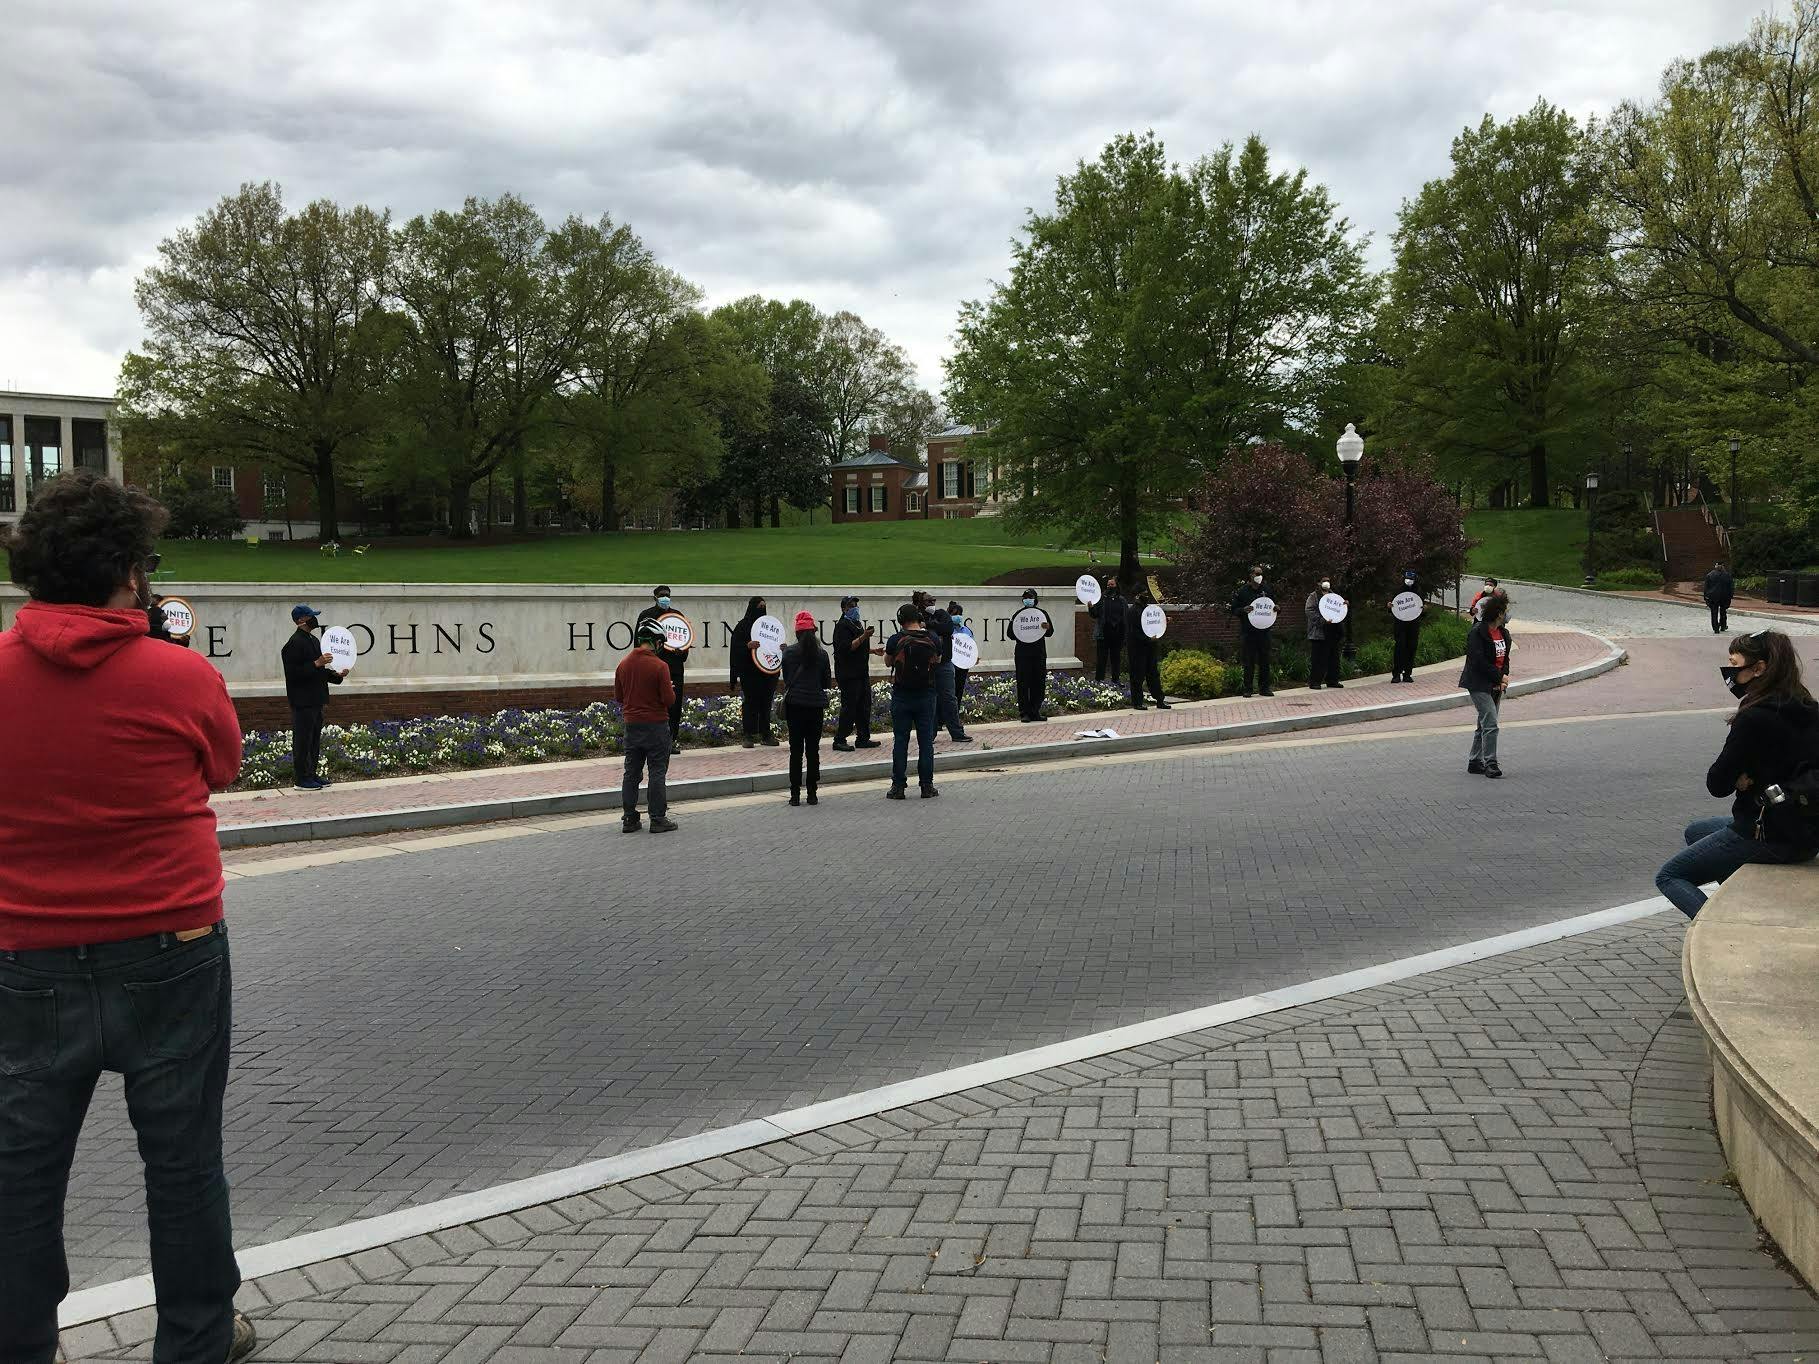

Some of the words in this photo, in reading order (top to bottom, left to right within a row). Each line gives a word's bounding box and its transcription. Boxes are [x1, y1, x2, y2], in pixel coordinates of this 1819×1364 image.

[169, 618, 189, 627] ERE!
[761, 621, 769, 629] We
[770, 625, 779, 634] Are
[330, 634, 339, 644] We
[340, 637, 350, 646] Are
[667, 632, 687, 642] ERE!
